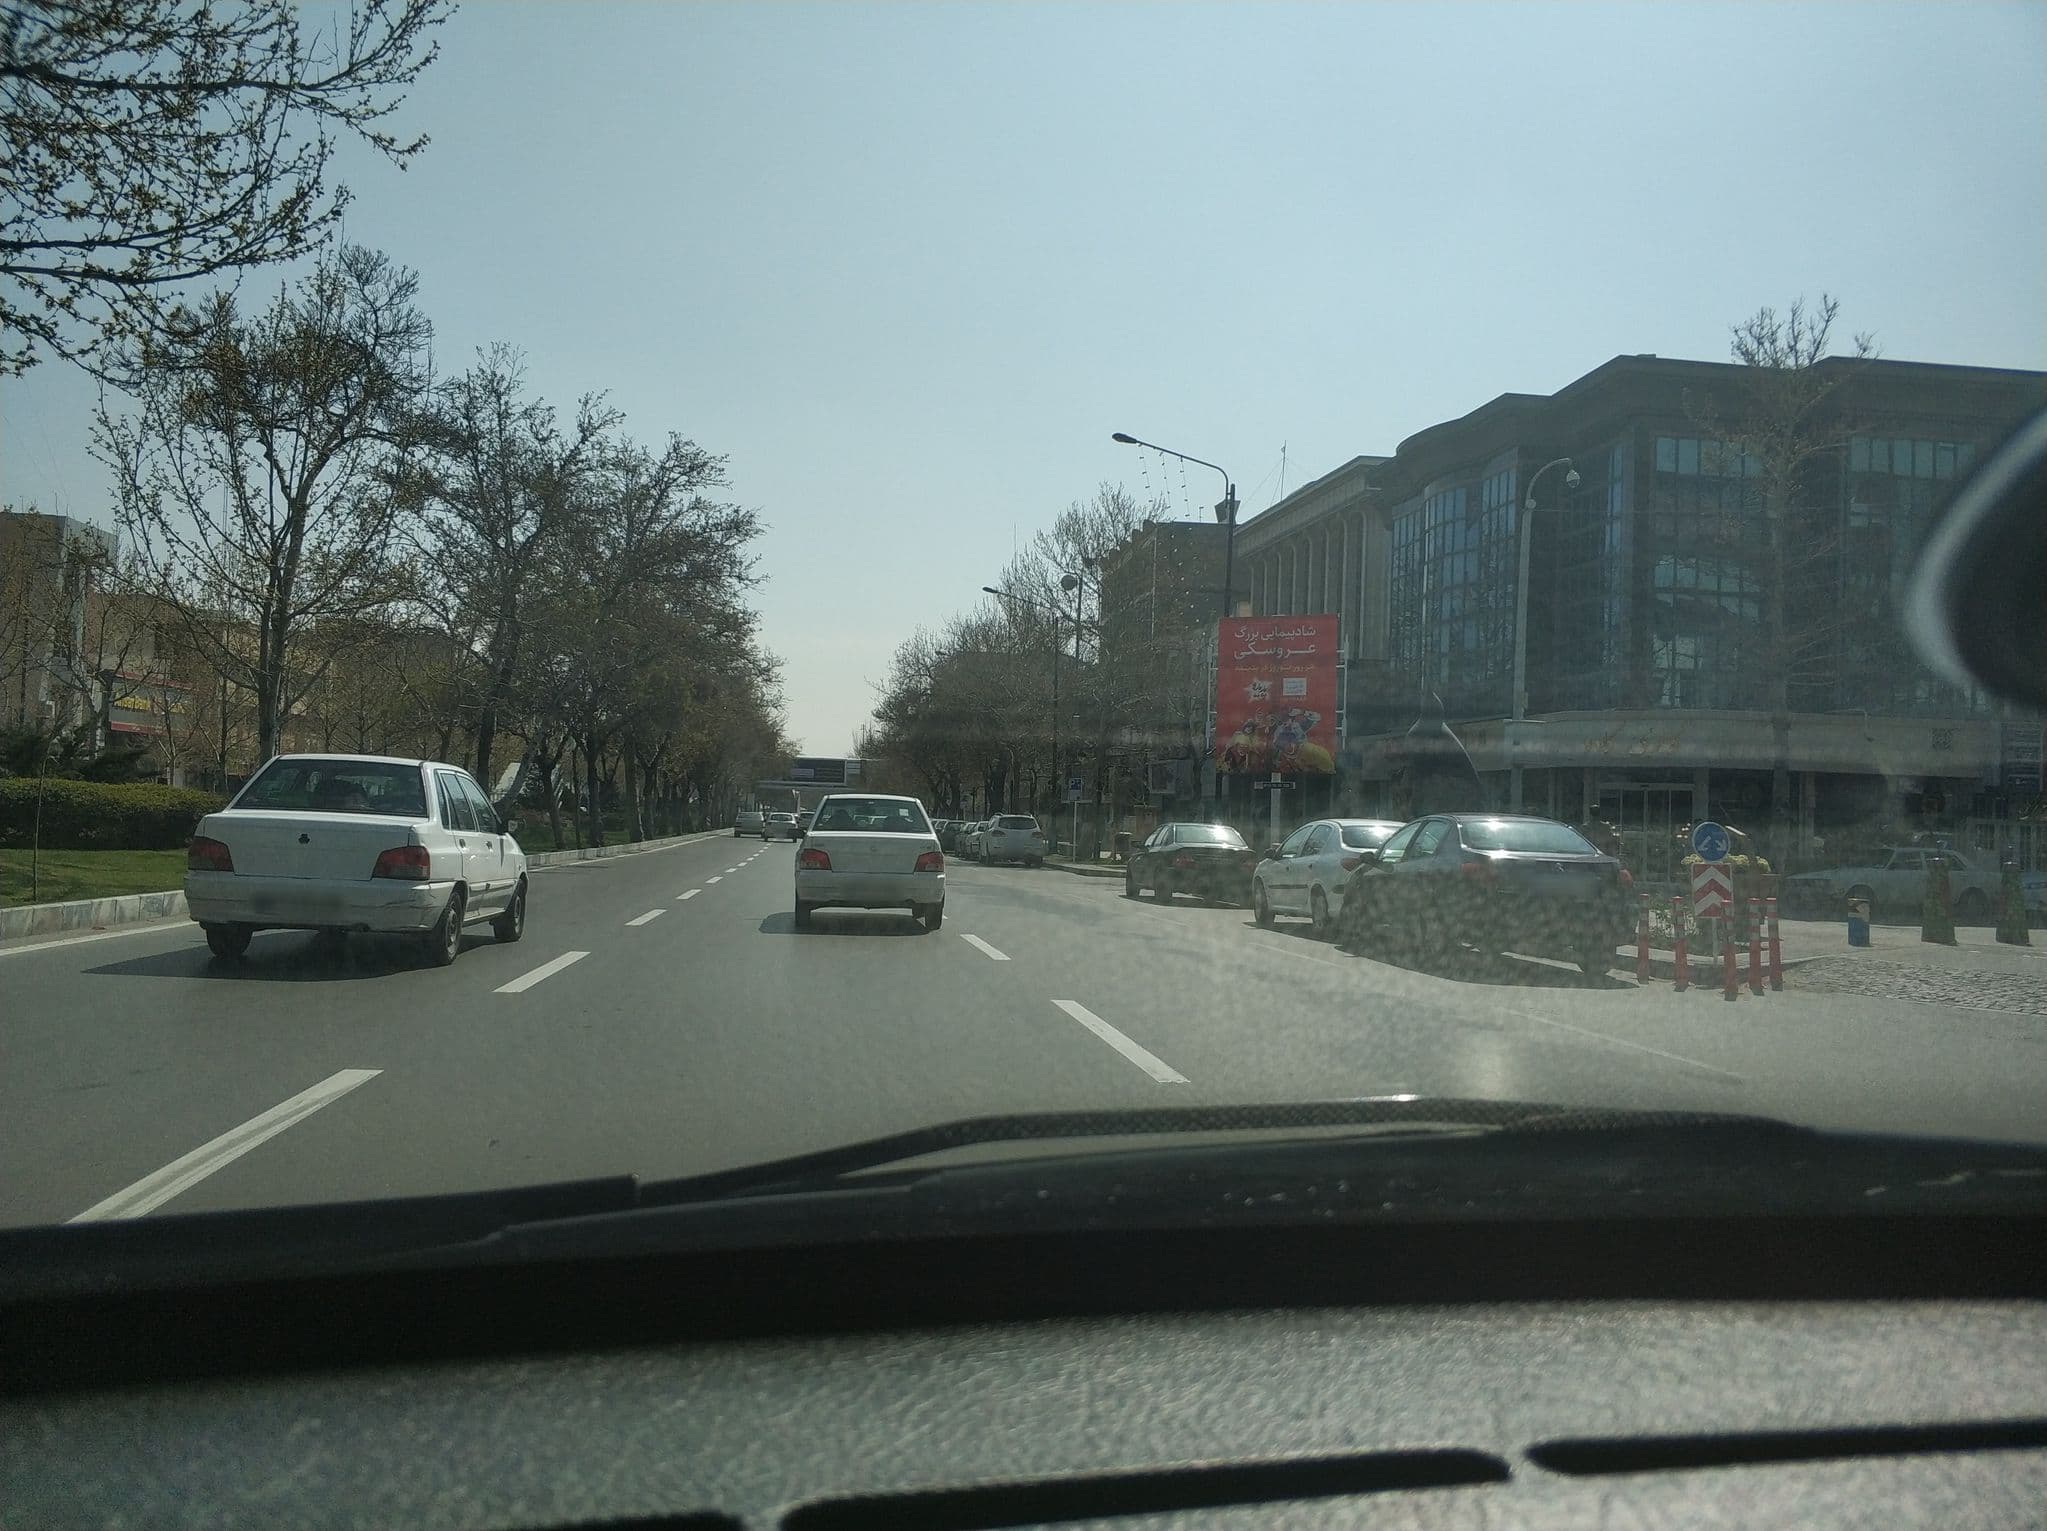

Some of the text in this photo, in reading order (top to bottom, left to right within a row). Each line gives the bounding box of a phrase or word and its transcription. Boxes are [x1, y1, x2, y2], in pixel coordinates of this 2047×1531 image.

[1234, 625, 1316, 642] شادپیمایی بزرگ
[1233, 641, 1316, 660] عروسکی
